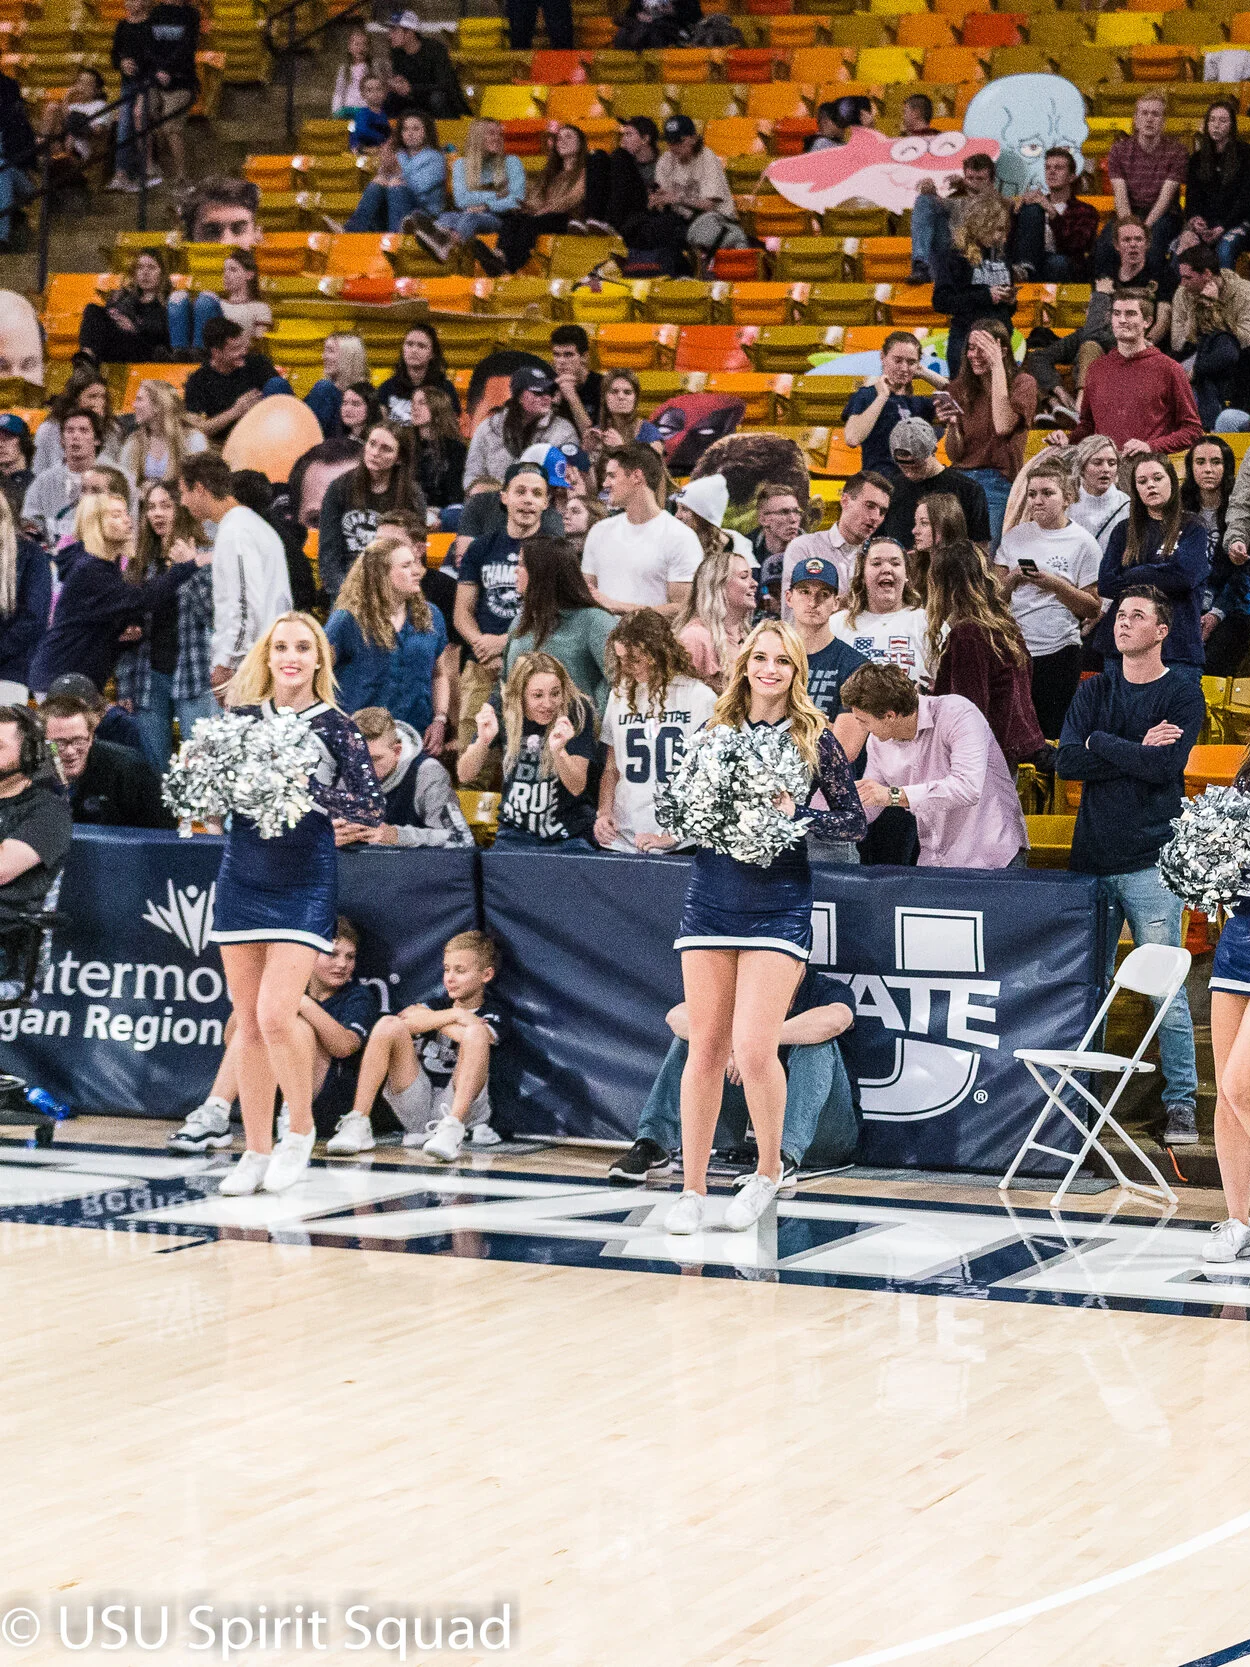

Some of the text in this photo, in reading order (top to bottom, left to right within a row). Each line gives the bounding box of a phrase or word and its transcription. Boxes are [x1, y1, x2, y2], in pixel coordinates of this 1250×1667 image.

[625, 727, 689, 784] 50
[508, 778, 560, 814] RUE
[83, 1004, 225, 1052] Region
[817, 971, 1001, 1049] ATE
